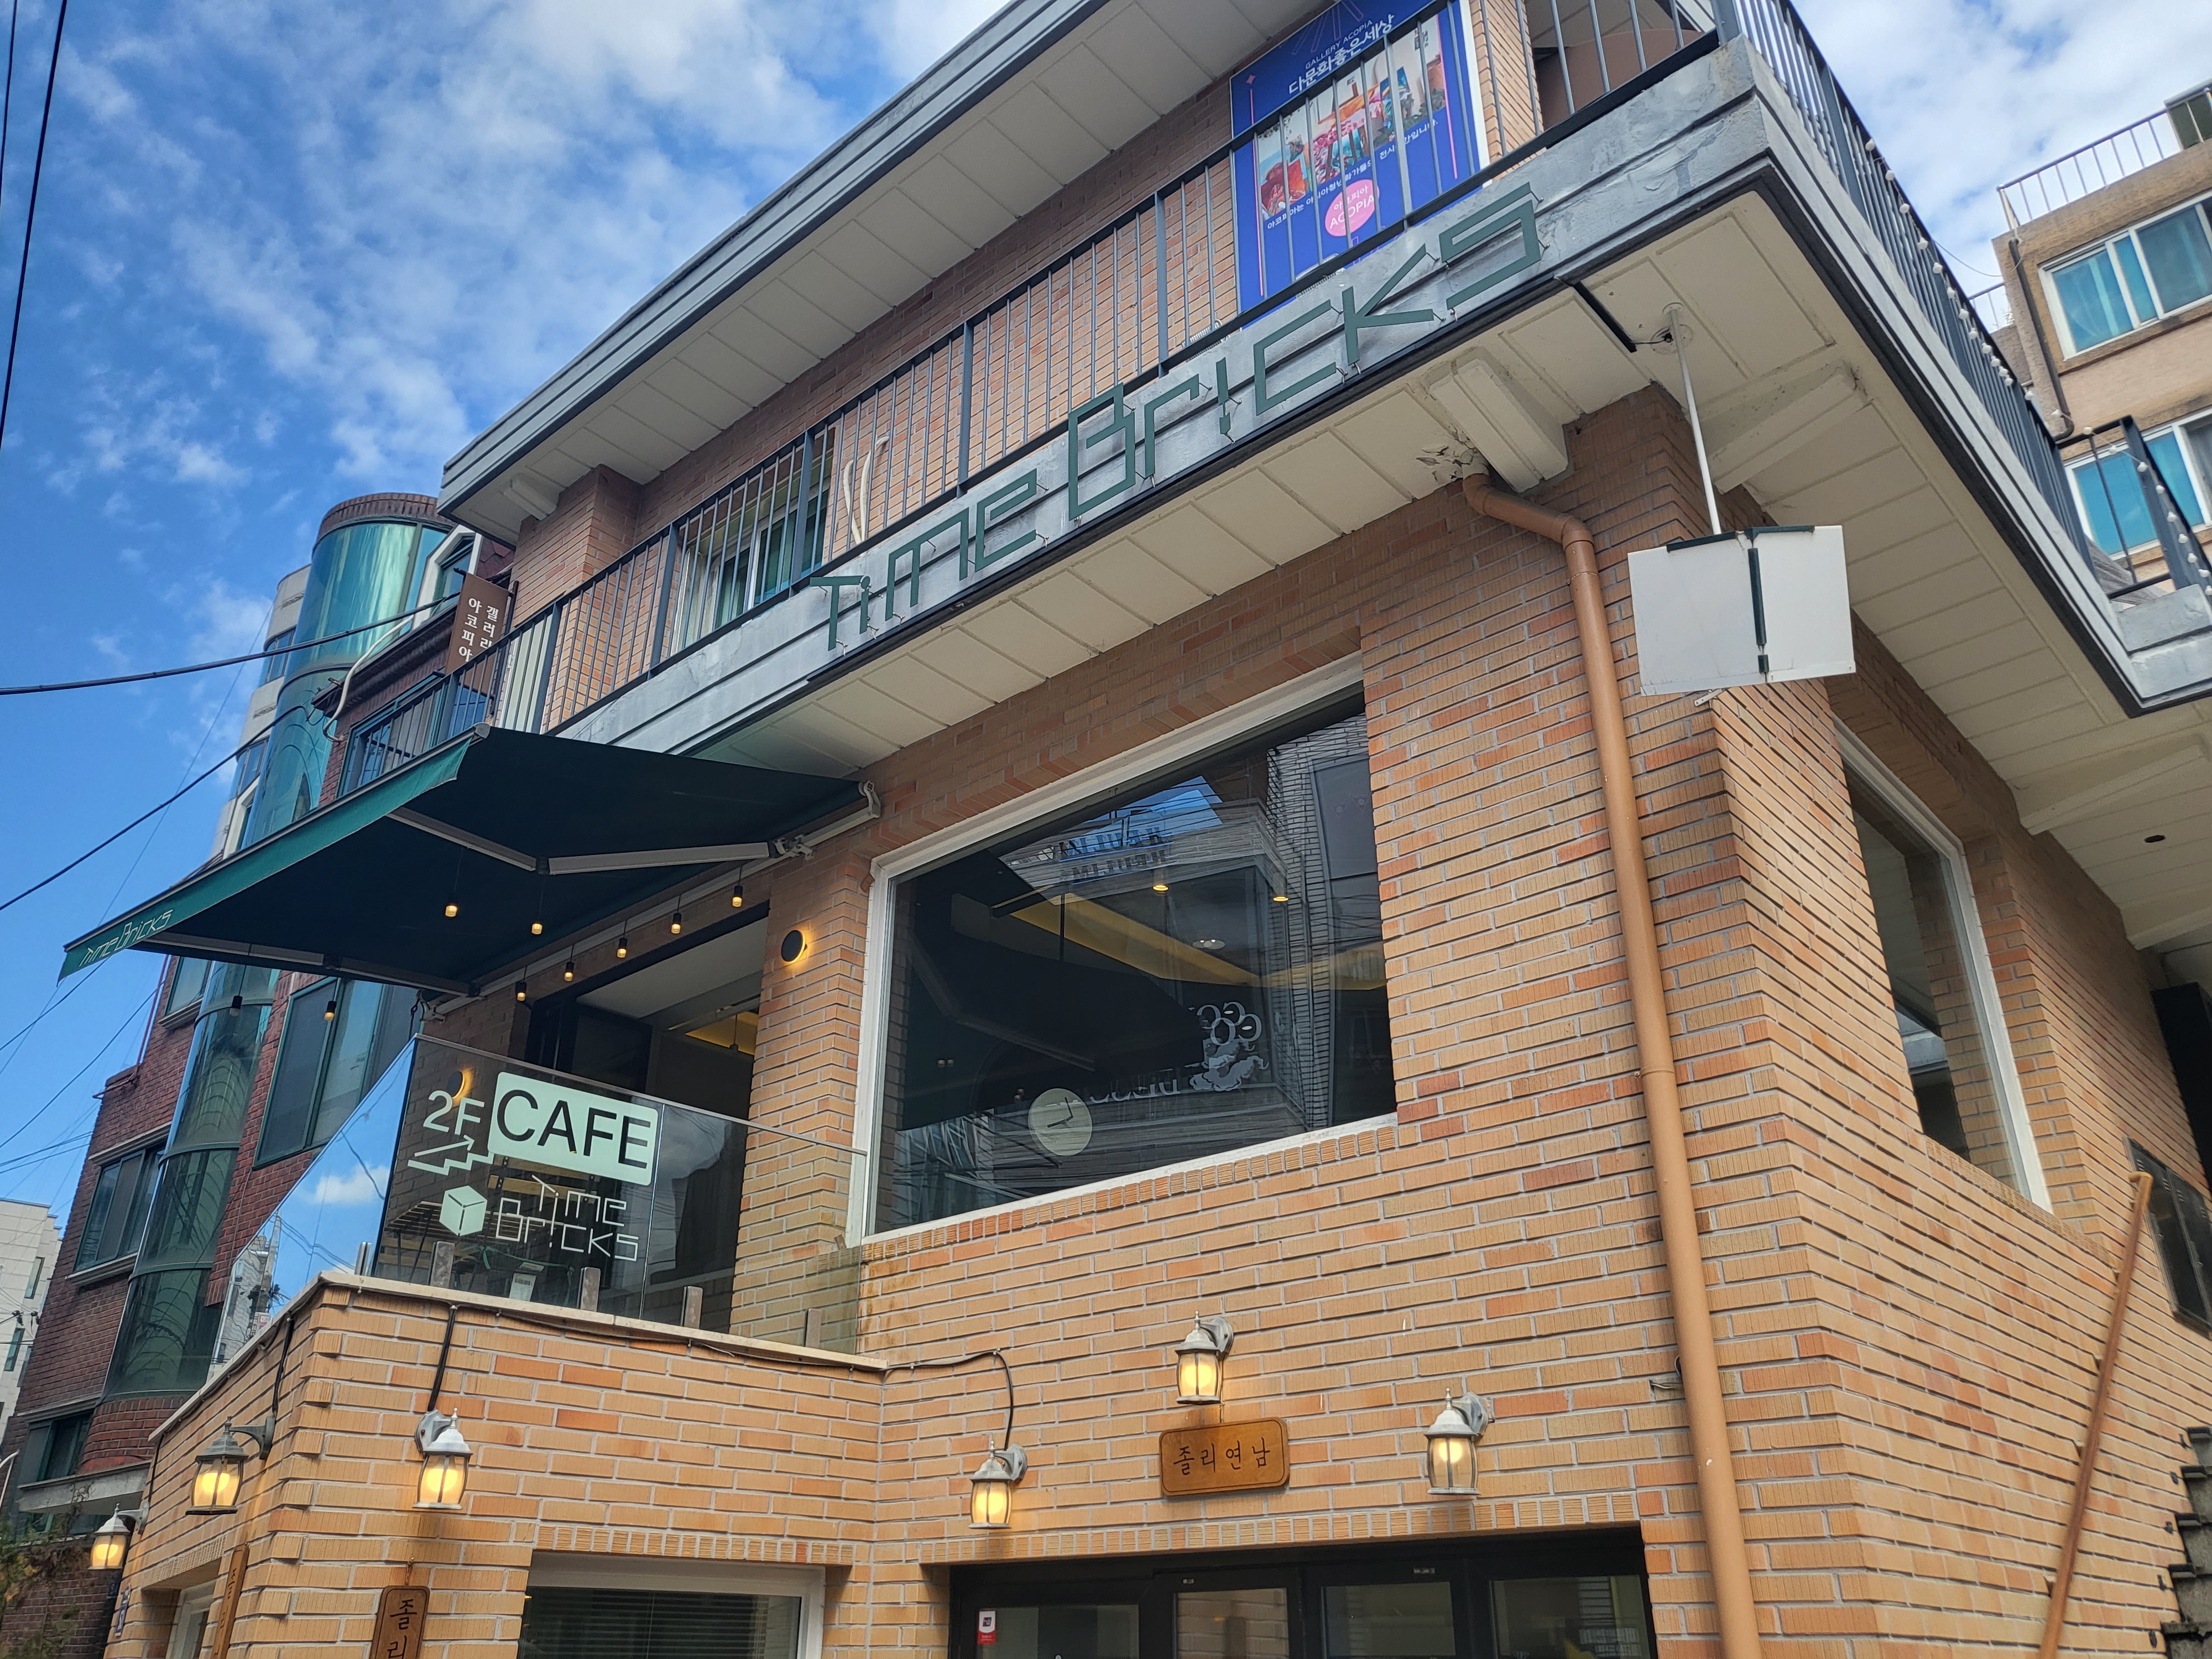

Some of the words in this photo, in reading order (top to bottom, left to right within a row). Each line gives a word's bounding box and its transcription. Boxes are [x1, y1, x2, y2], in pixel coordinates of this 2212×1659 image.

[1306, 41, 1341, 69] GALLERY
[1343, 20, 1373, 44] ACOPIA
[1330, 195, 1375, 229] ACOPIA
[459, 598, 483, 662] 아코피아
[480, 605, 499, 650] 갤러리
[423, 1090, 484, 1135] 2F
[497, 1089, 651, 1170] CAFE
[387, 1599, 418, 1659] 졸리
